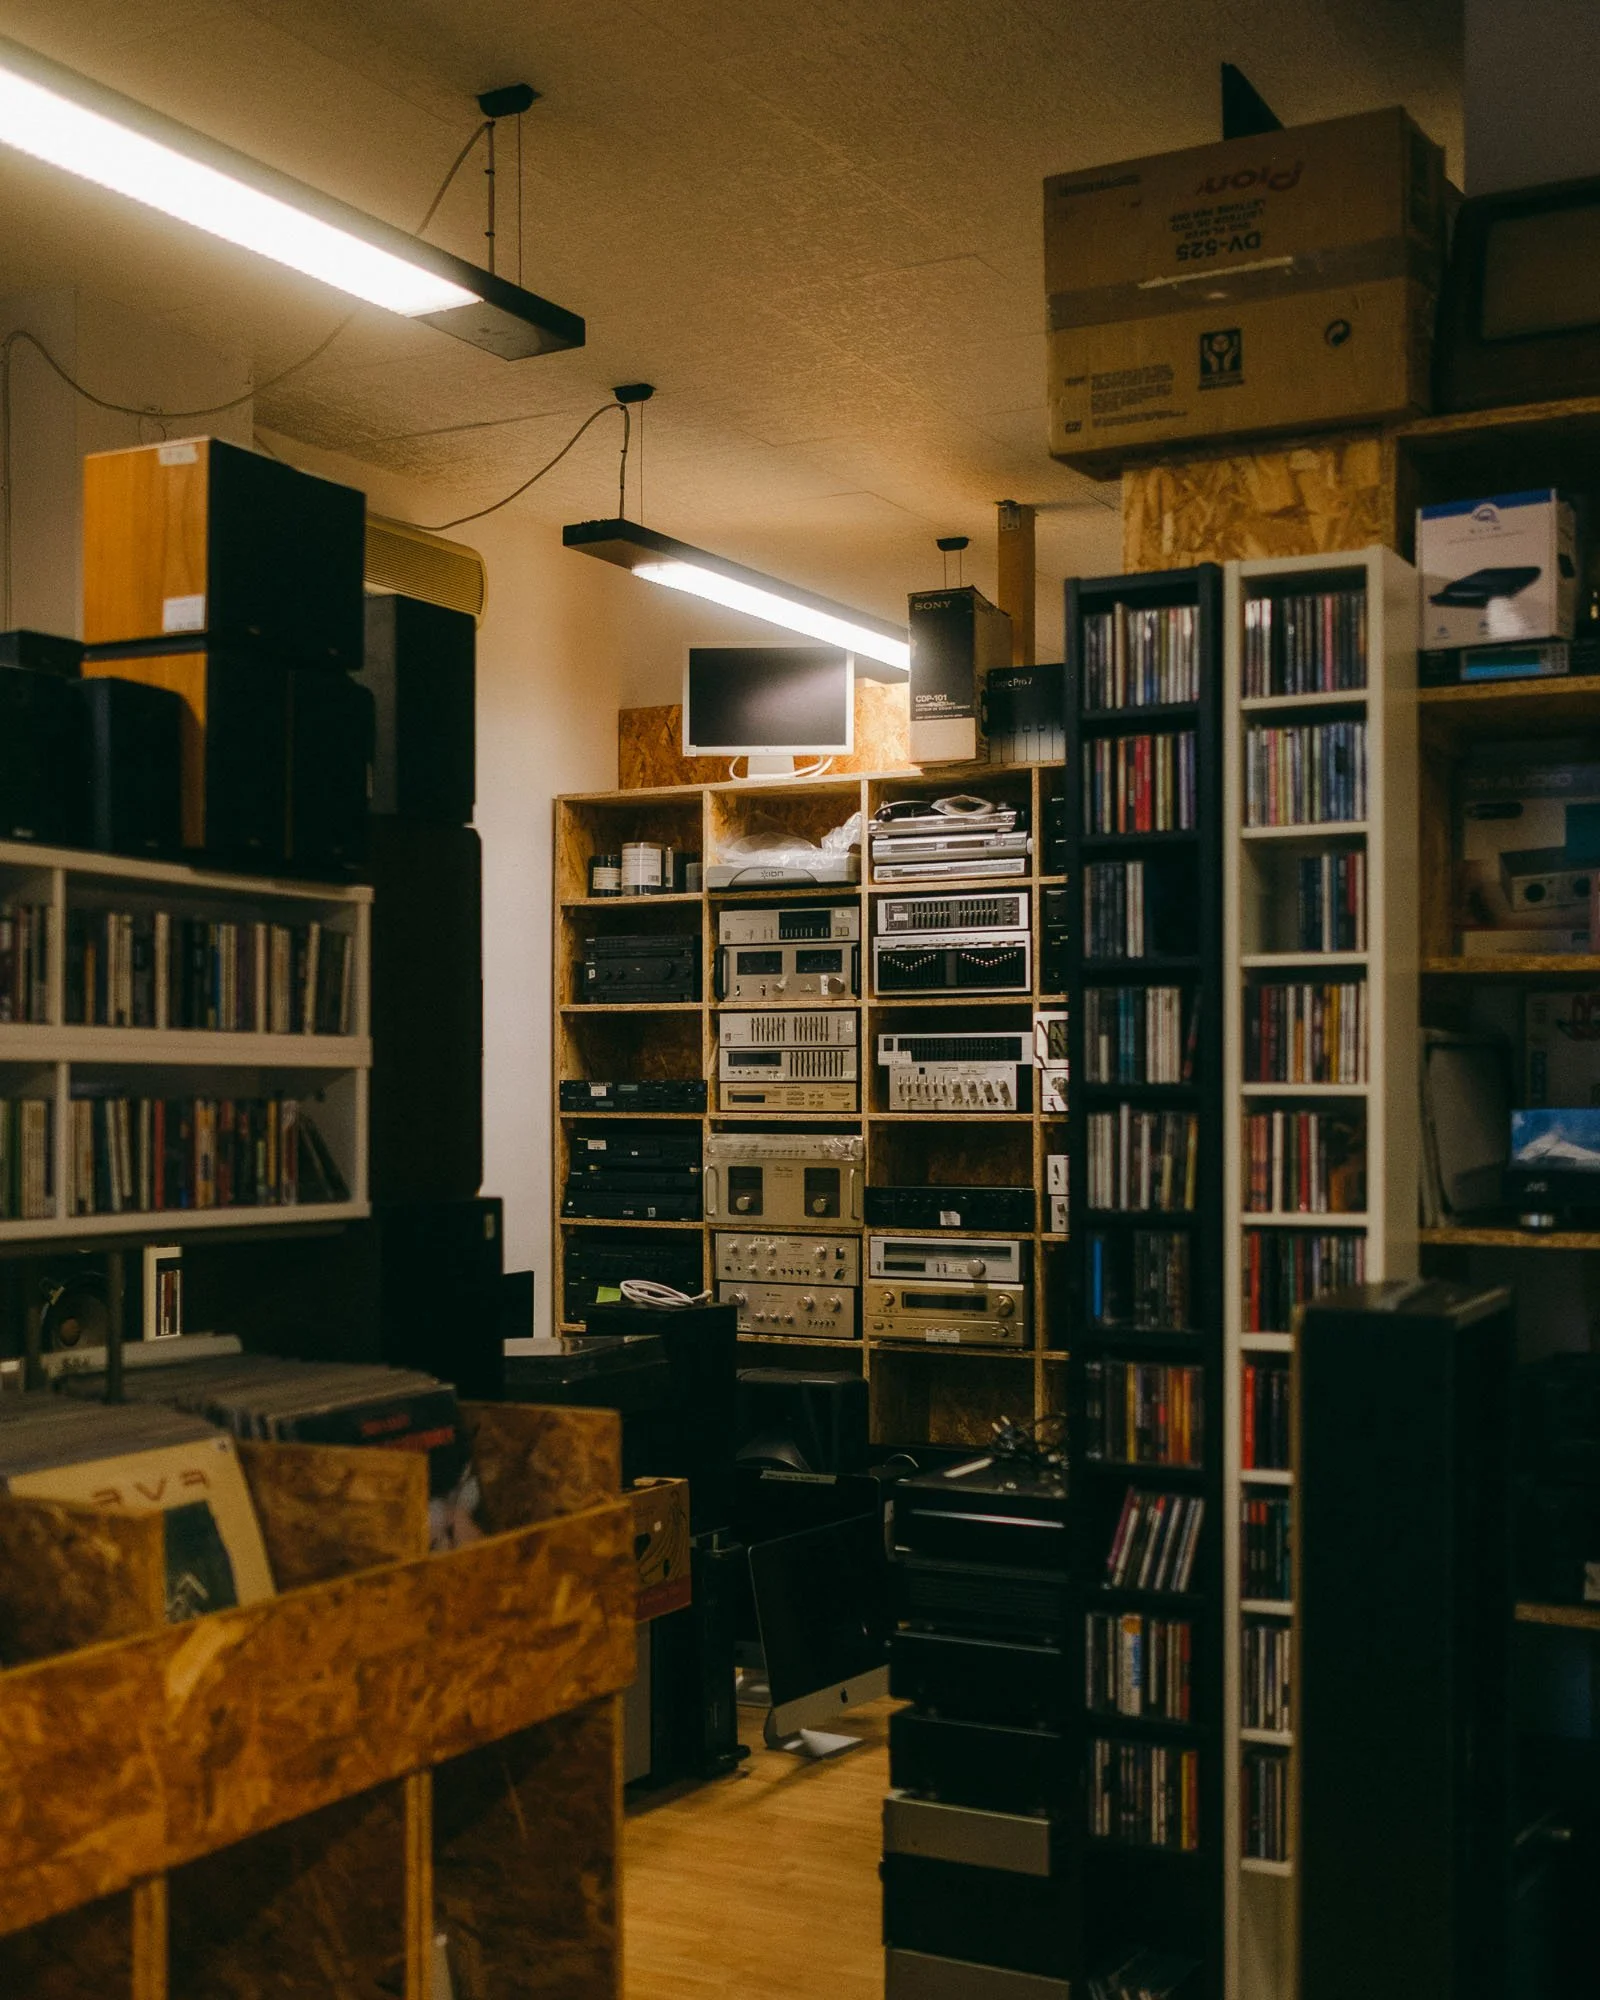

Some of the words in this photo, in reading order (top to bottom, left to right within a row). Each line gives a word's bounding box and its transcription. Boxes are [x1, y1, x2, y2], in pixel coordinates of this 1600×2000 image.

[1175, 230, 1262, 262] DV-525
[914, 600, 952, 611] SONY
[1013, 677, 1027, 686] Pro
[915, 694, 947, 703] CDP-101
